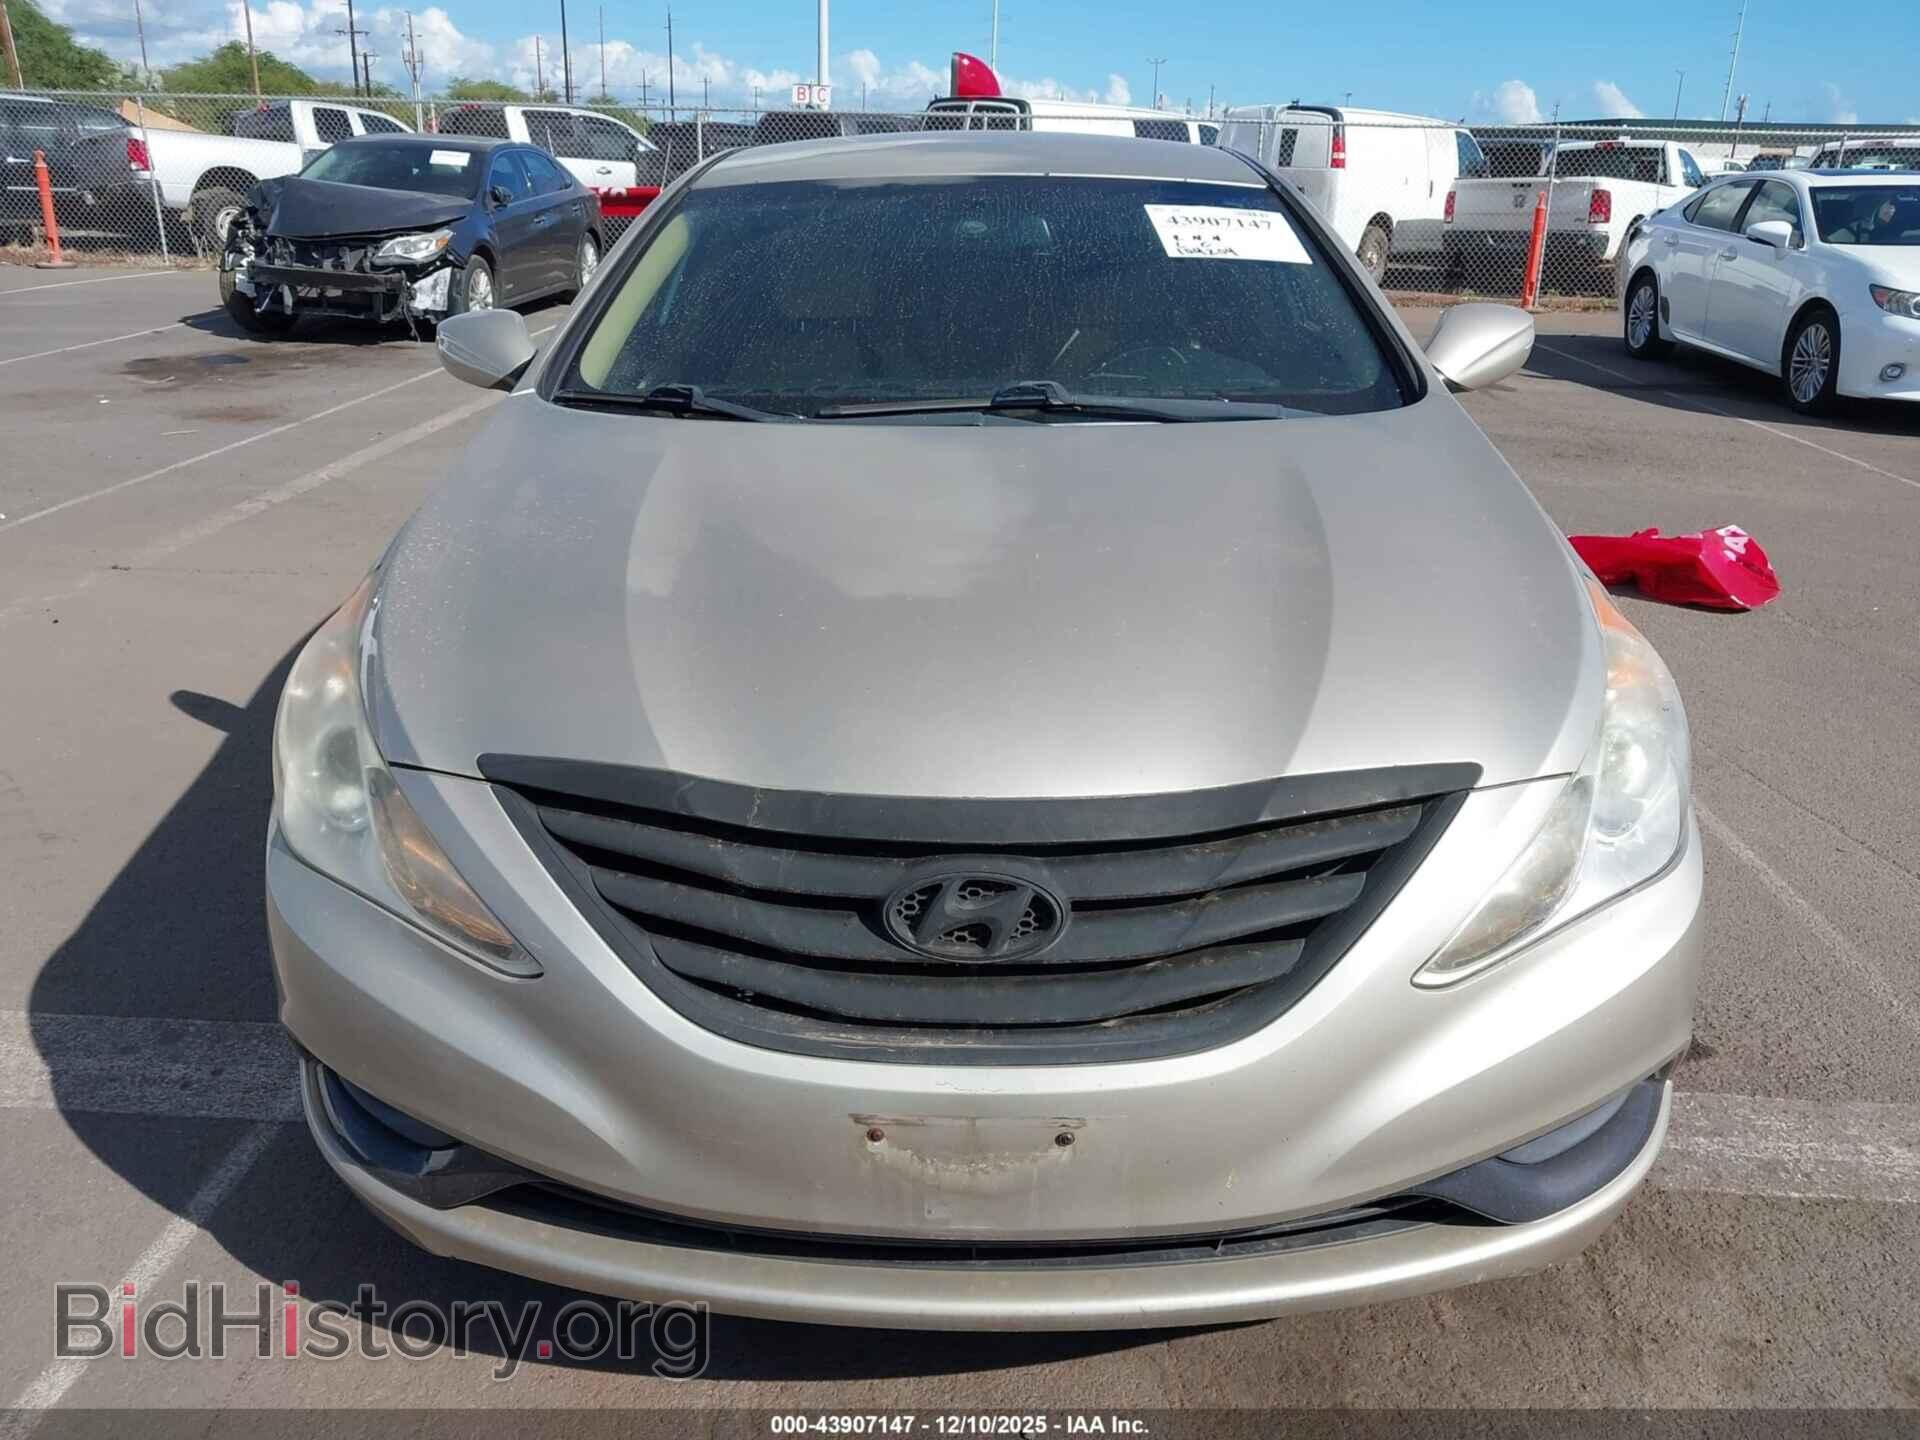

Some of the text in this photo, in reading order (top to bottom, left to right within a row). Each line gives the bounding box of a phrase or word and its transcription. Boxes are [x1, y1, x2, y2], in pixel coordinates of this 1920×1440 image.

[796, 86, 807, 101] B
[817, 88, 827, 103] C
[1166, 214, 1272, 230] 43907147
